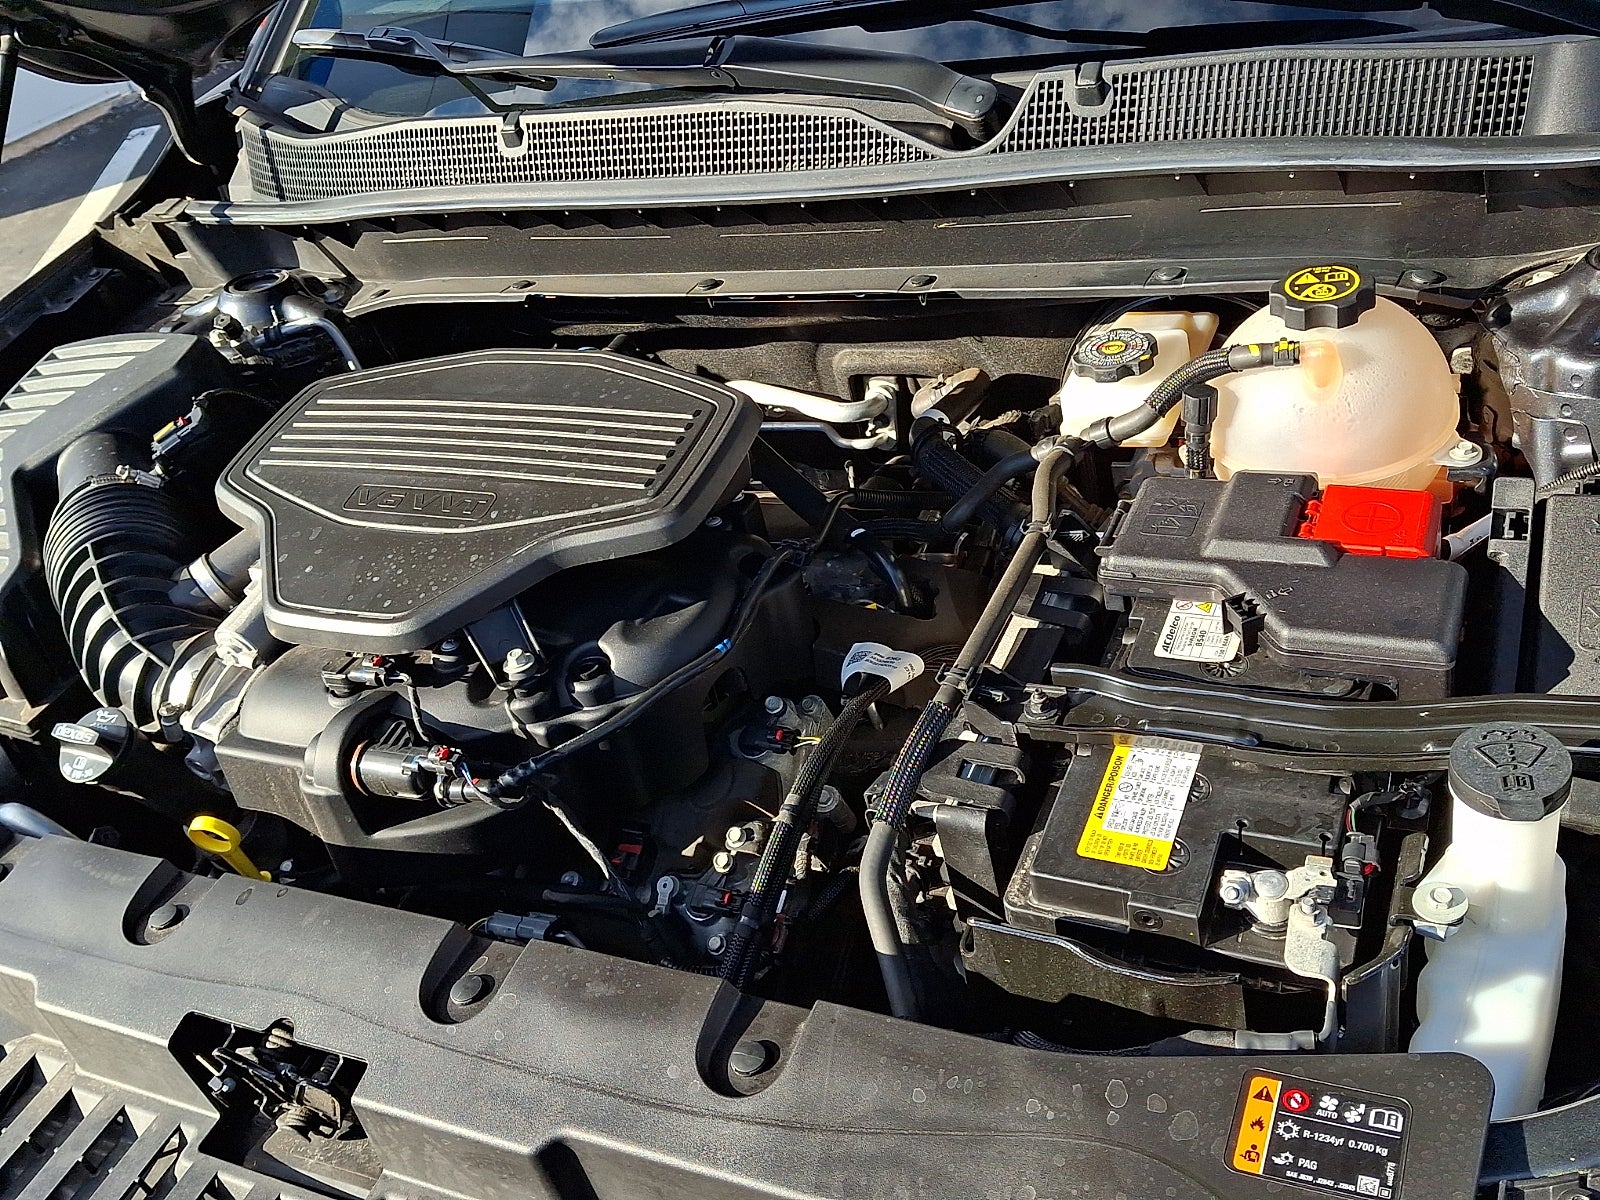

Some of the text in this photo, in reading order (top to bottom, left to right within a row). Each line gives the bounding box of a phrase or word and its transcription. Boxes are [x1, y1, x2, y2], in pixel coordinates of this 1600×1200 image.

[357, 488, 489, 514] V6 VVT
[1162, 615, 1181, 653] ACDelco
[1097, 755, 1125, 815] DANGER/POISON
[1316, 1109, 1338, 1120] AUTO
[1302, 1129, 1389, 1157] R-1234yf 0.700 kg
[1297, 1158, 1318, 1171] PAG
